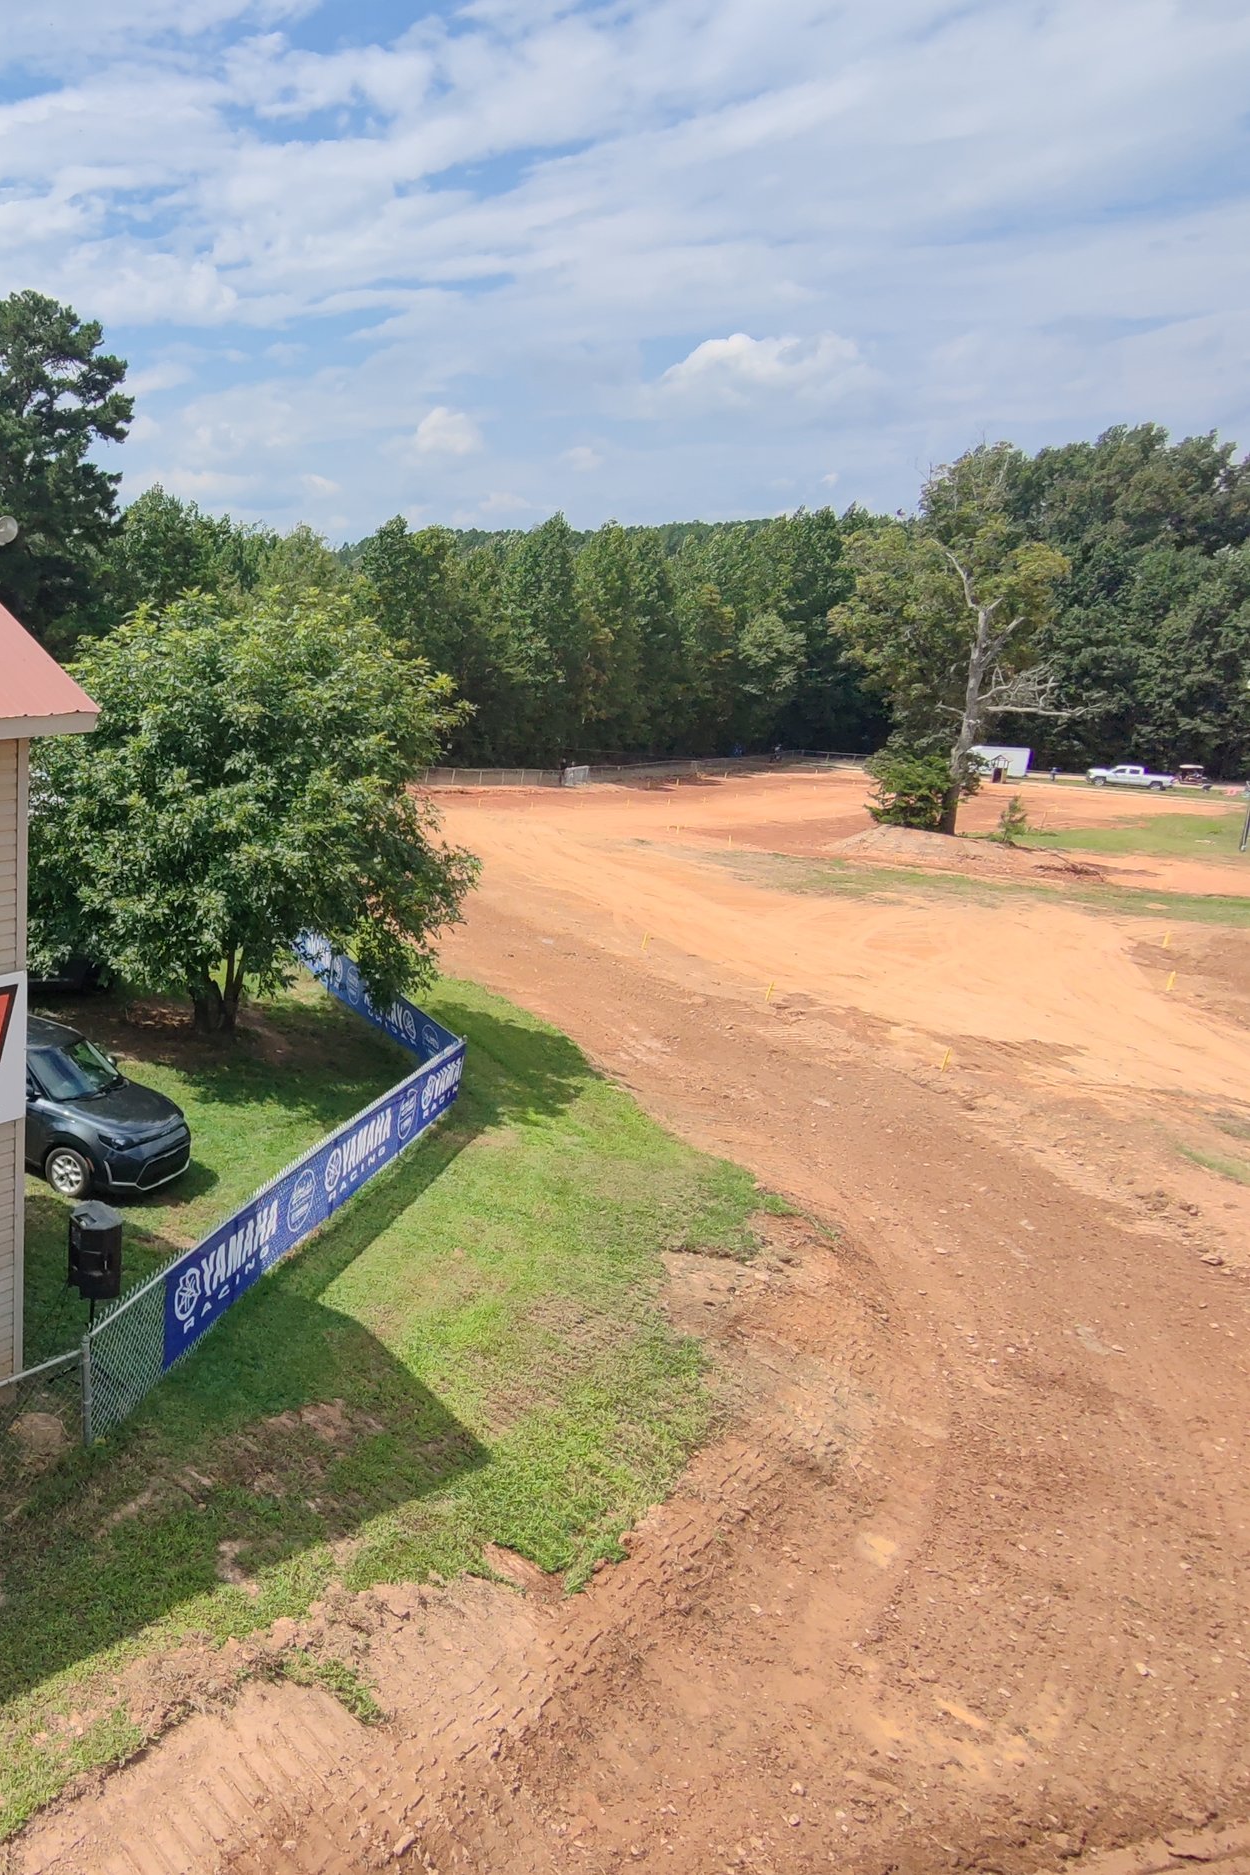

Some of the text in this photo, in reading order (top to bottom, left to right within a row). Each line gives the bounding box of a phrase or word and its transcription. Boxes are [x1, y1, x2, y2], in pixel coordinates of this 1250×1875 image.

[328, 1146, 386, 1202] RACING
[342, 1107, 392, 1177] YAMAHA
[201, 1200, 278, 1297] YAMAHA
[184, 1245, 269, 1334] RACING
